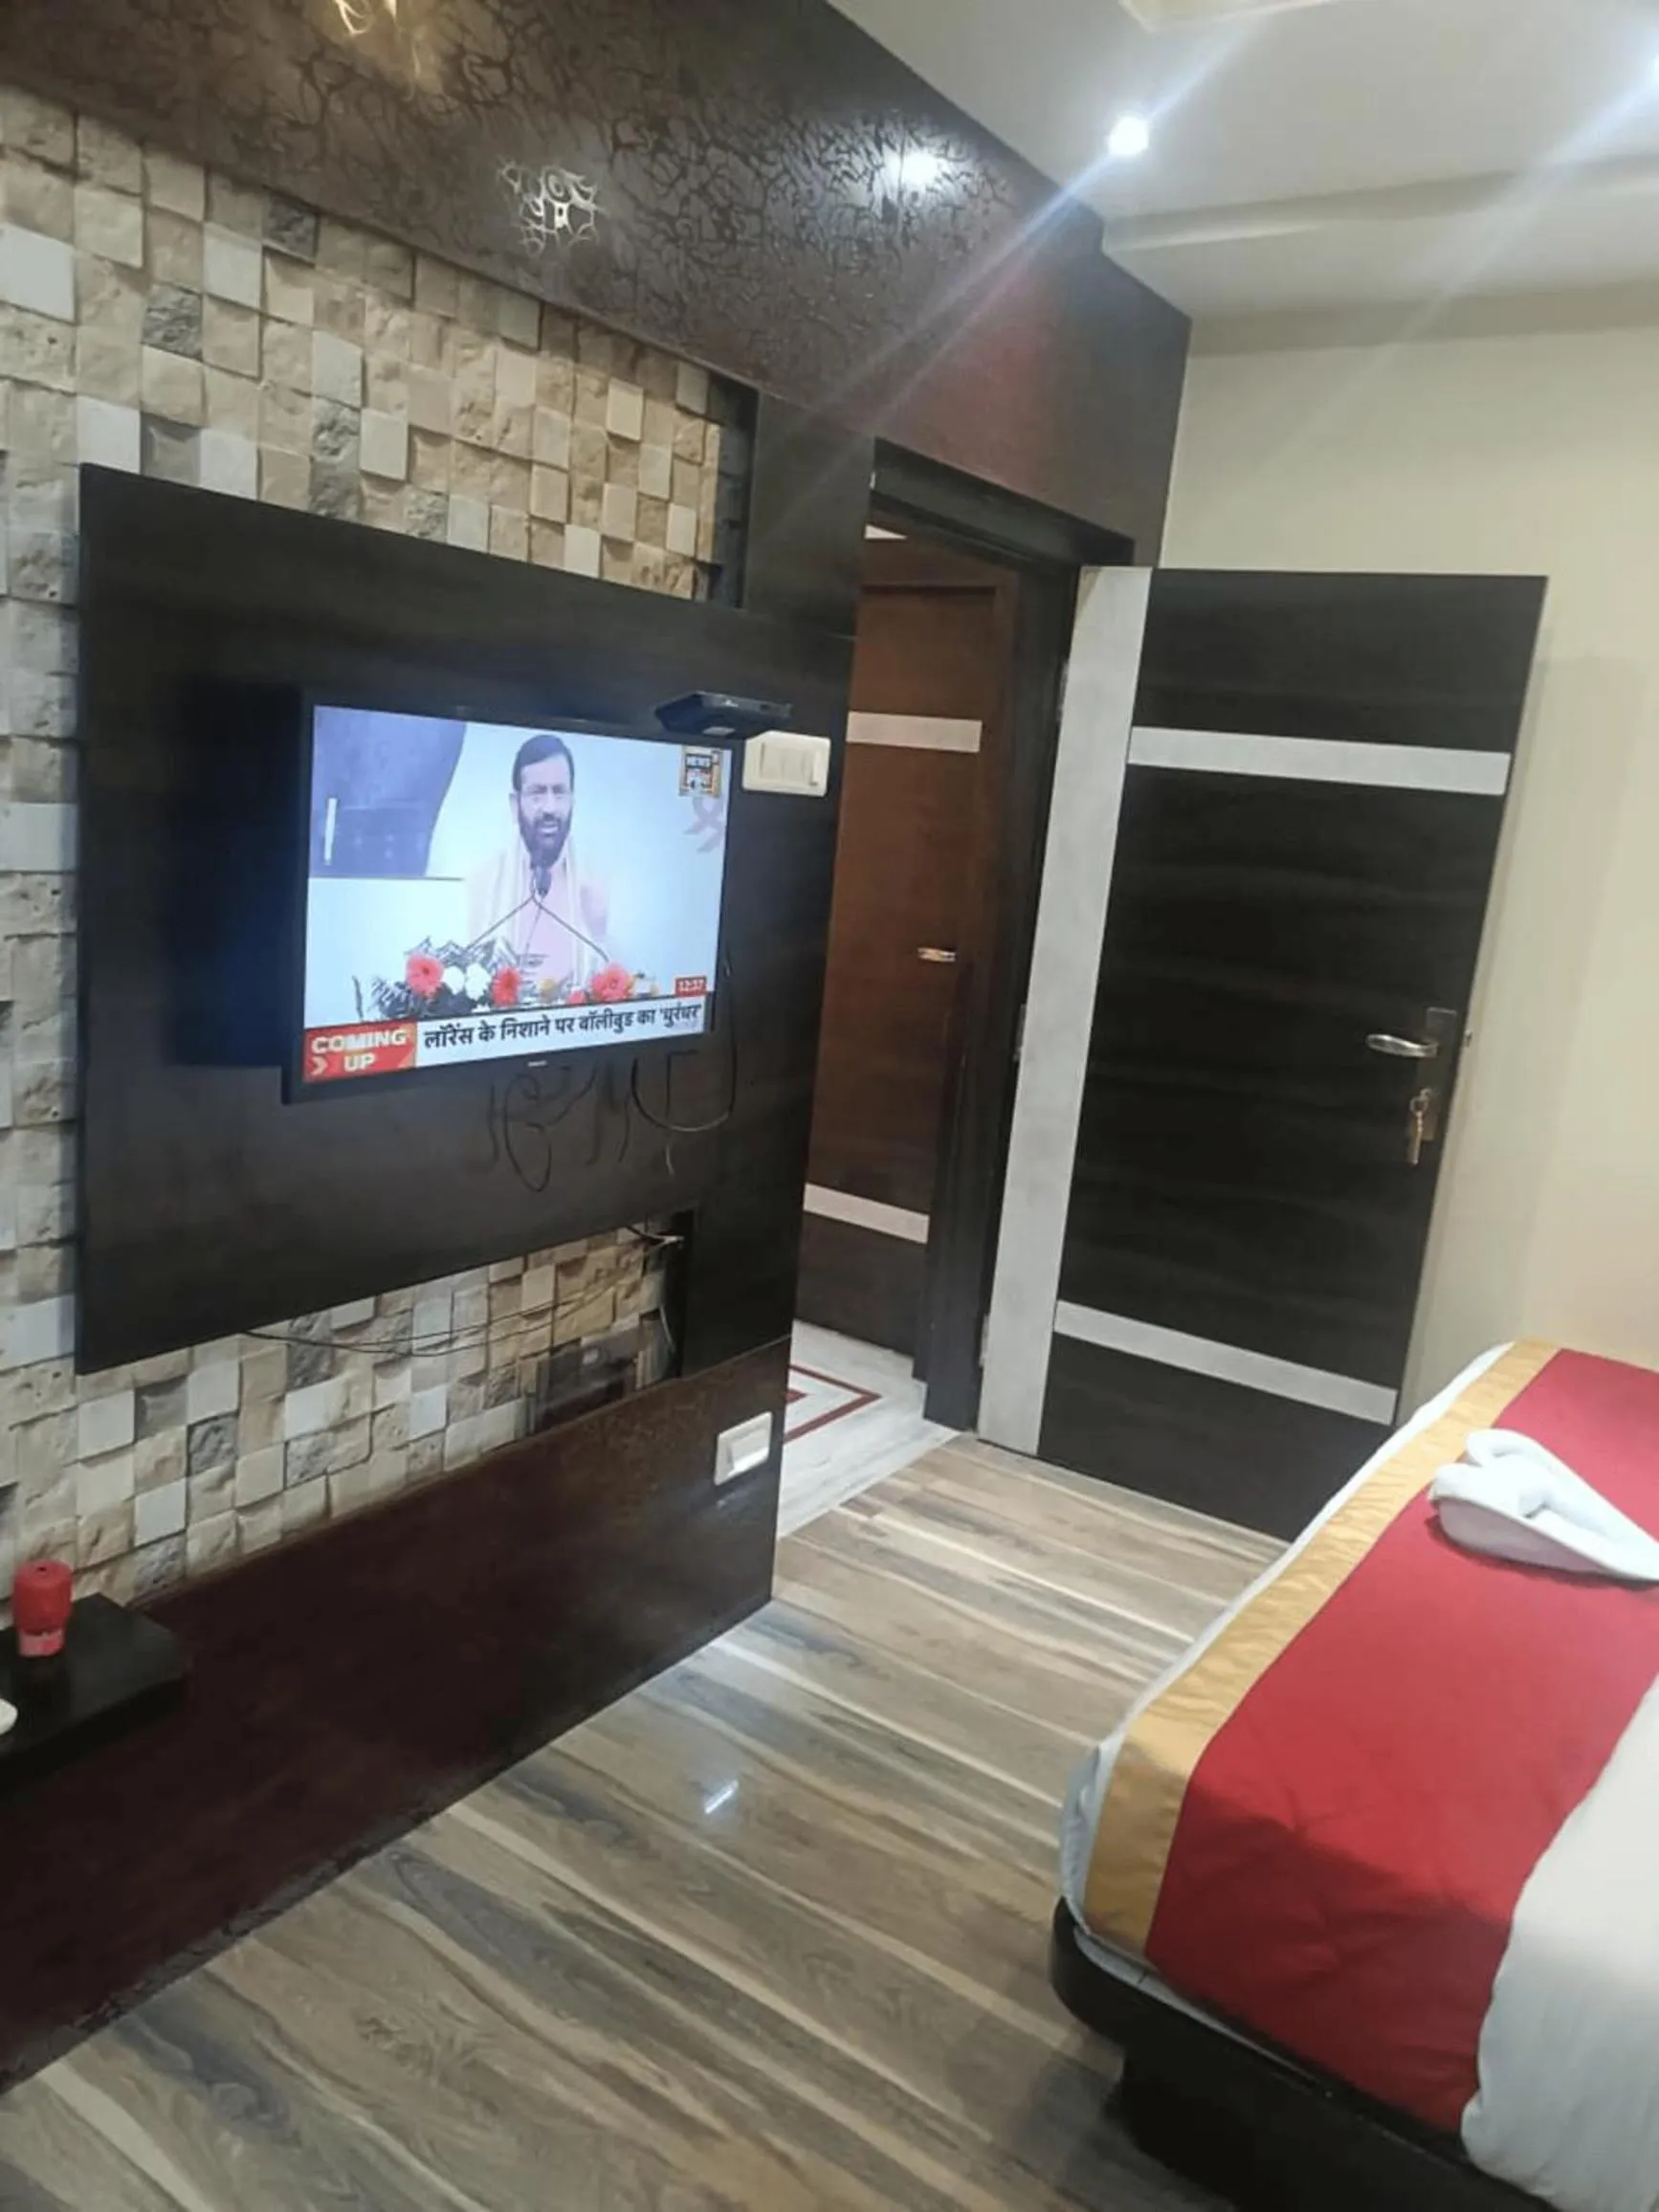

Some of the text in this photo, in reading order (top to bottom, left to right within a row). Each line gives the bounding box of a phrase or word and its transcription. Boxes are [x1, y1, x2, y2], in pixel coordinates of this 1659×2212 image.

[311, 1028, 408, 1054] COMING
[423, 1022, 475, 1049] लॉरेंस
[477, 1019, 497, 1042] के
[498, 1013, 550, 1041] निशाने
[555, 1016, 575, 1034] पर
[637, 1008, 656, 1026] का
[343, 1052, 376, 1073] UP
